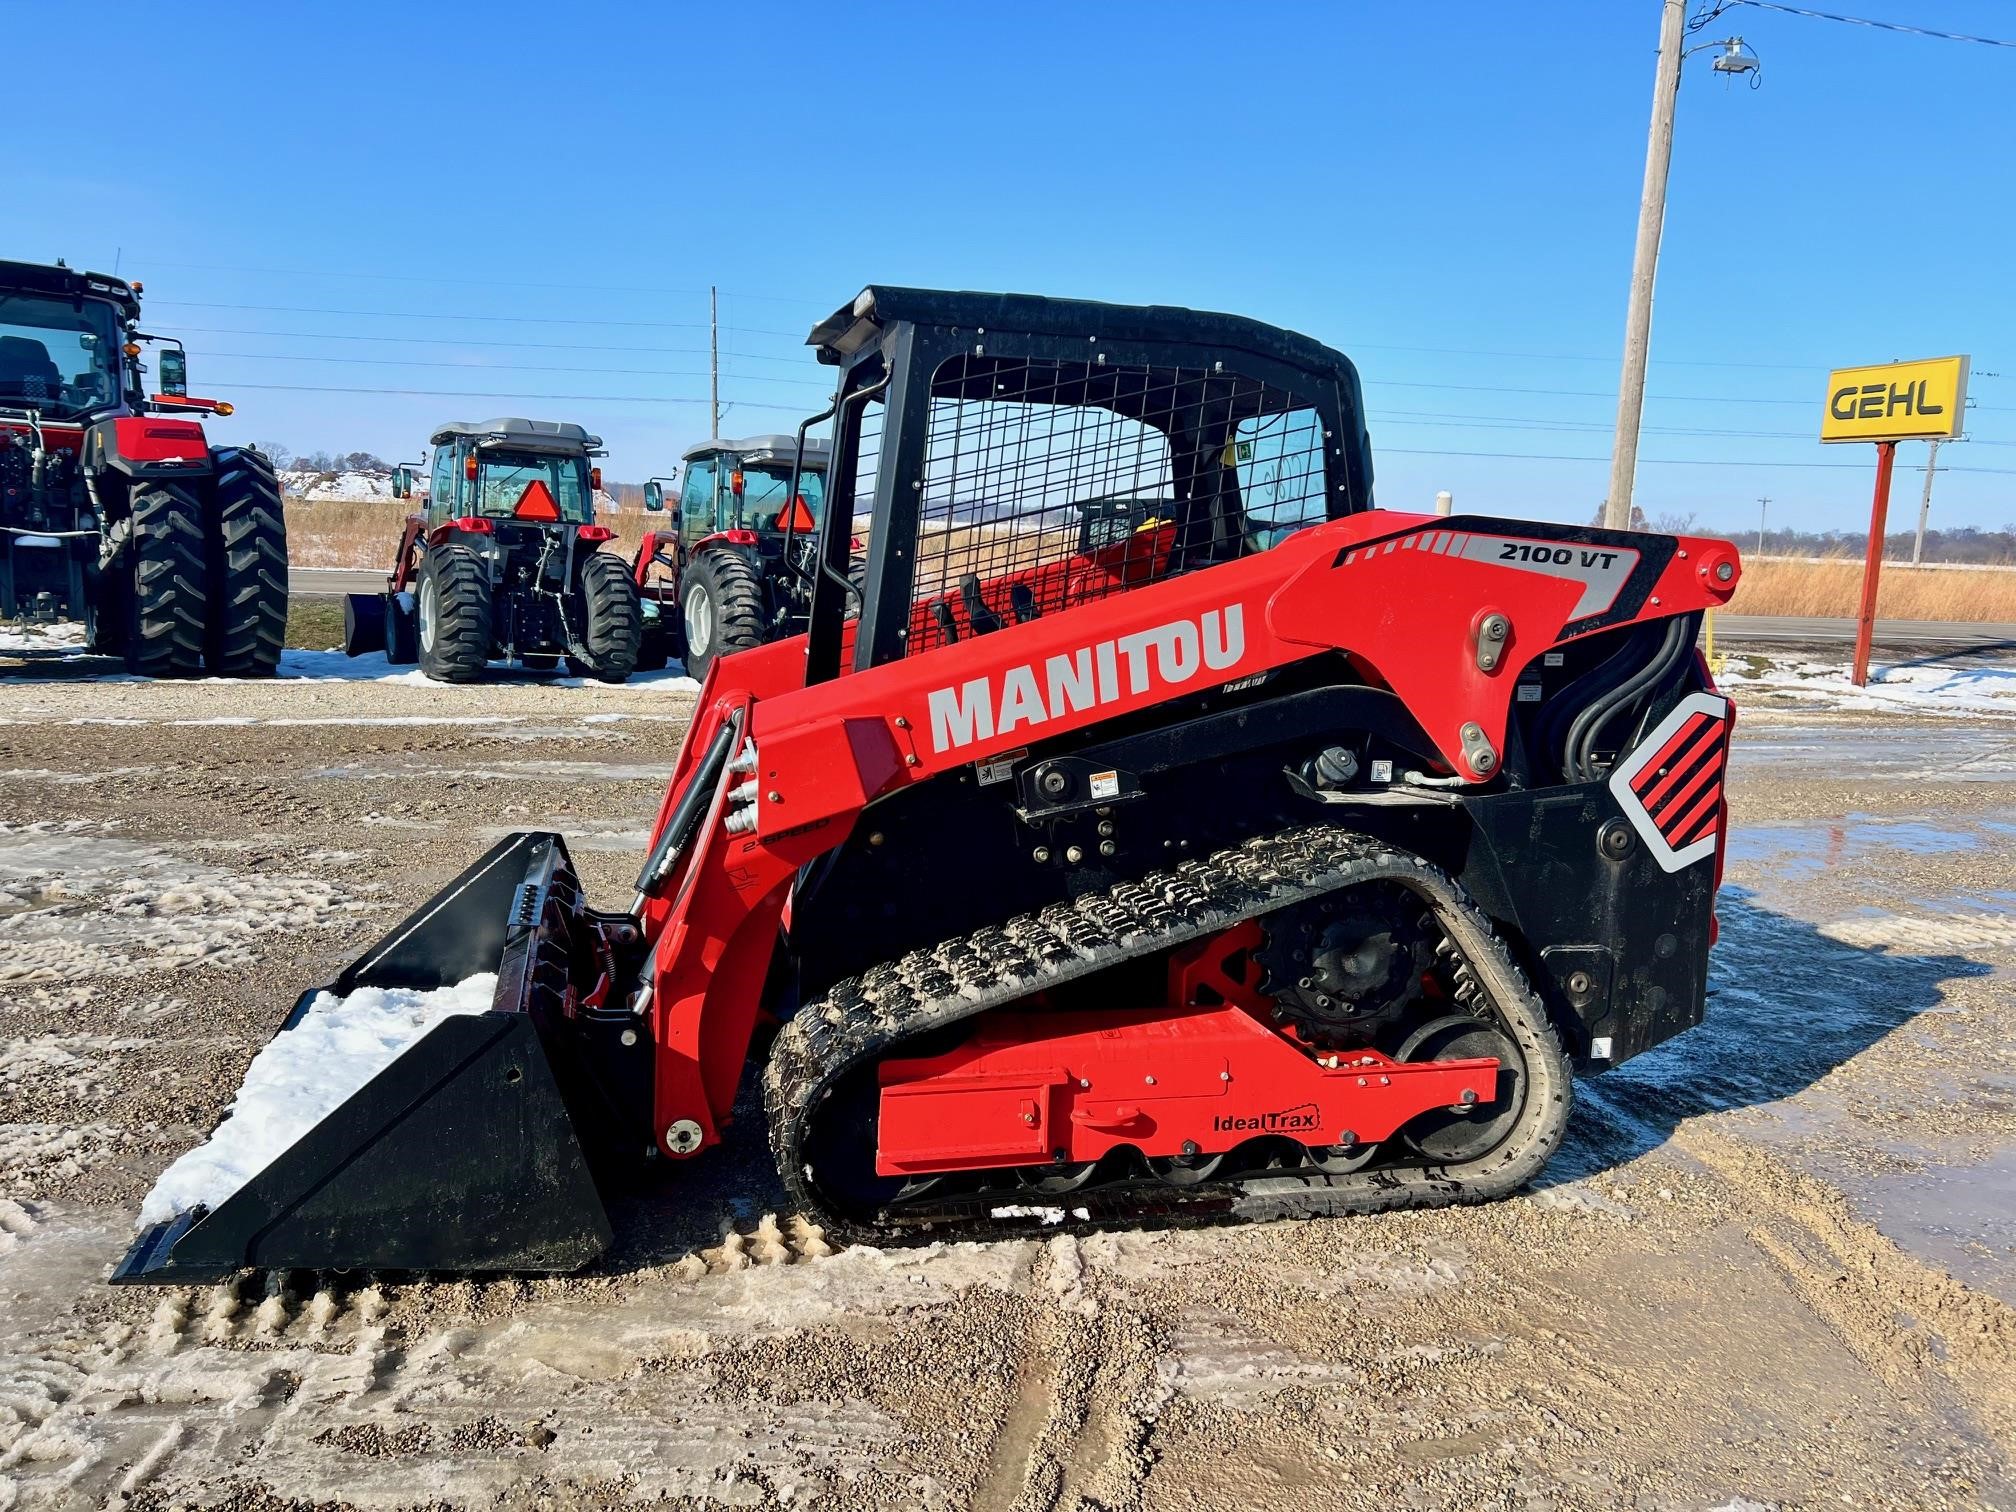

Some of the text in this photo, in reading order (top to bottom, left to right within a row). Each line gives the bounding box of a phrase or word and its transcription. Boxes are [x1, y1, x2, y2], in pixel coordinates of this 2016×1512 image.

[1831, 379, 1943, 420] GEHL
[1499, 543, 1618, 570] 2100 VT
[928, 603, 1245, 754] MANITOU
[1213, 1113, 1315, 1132] IdealTrax
